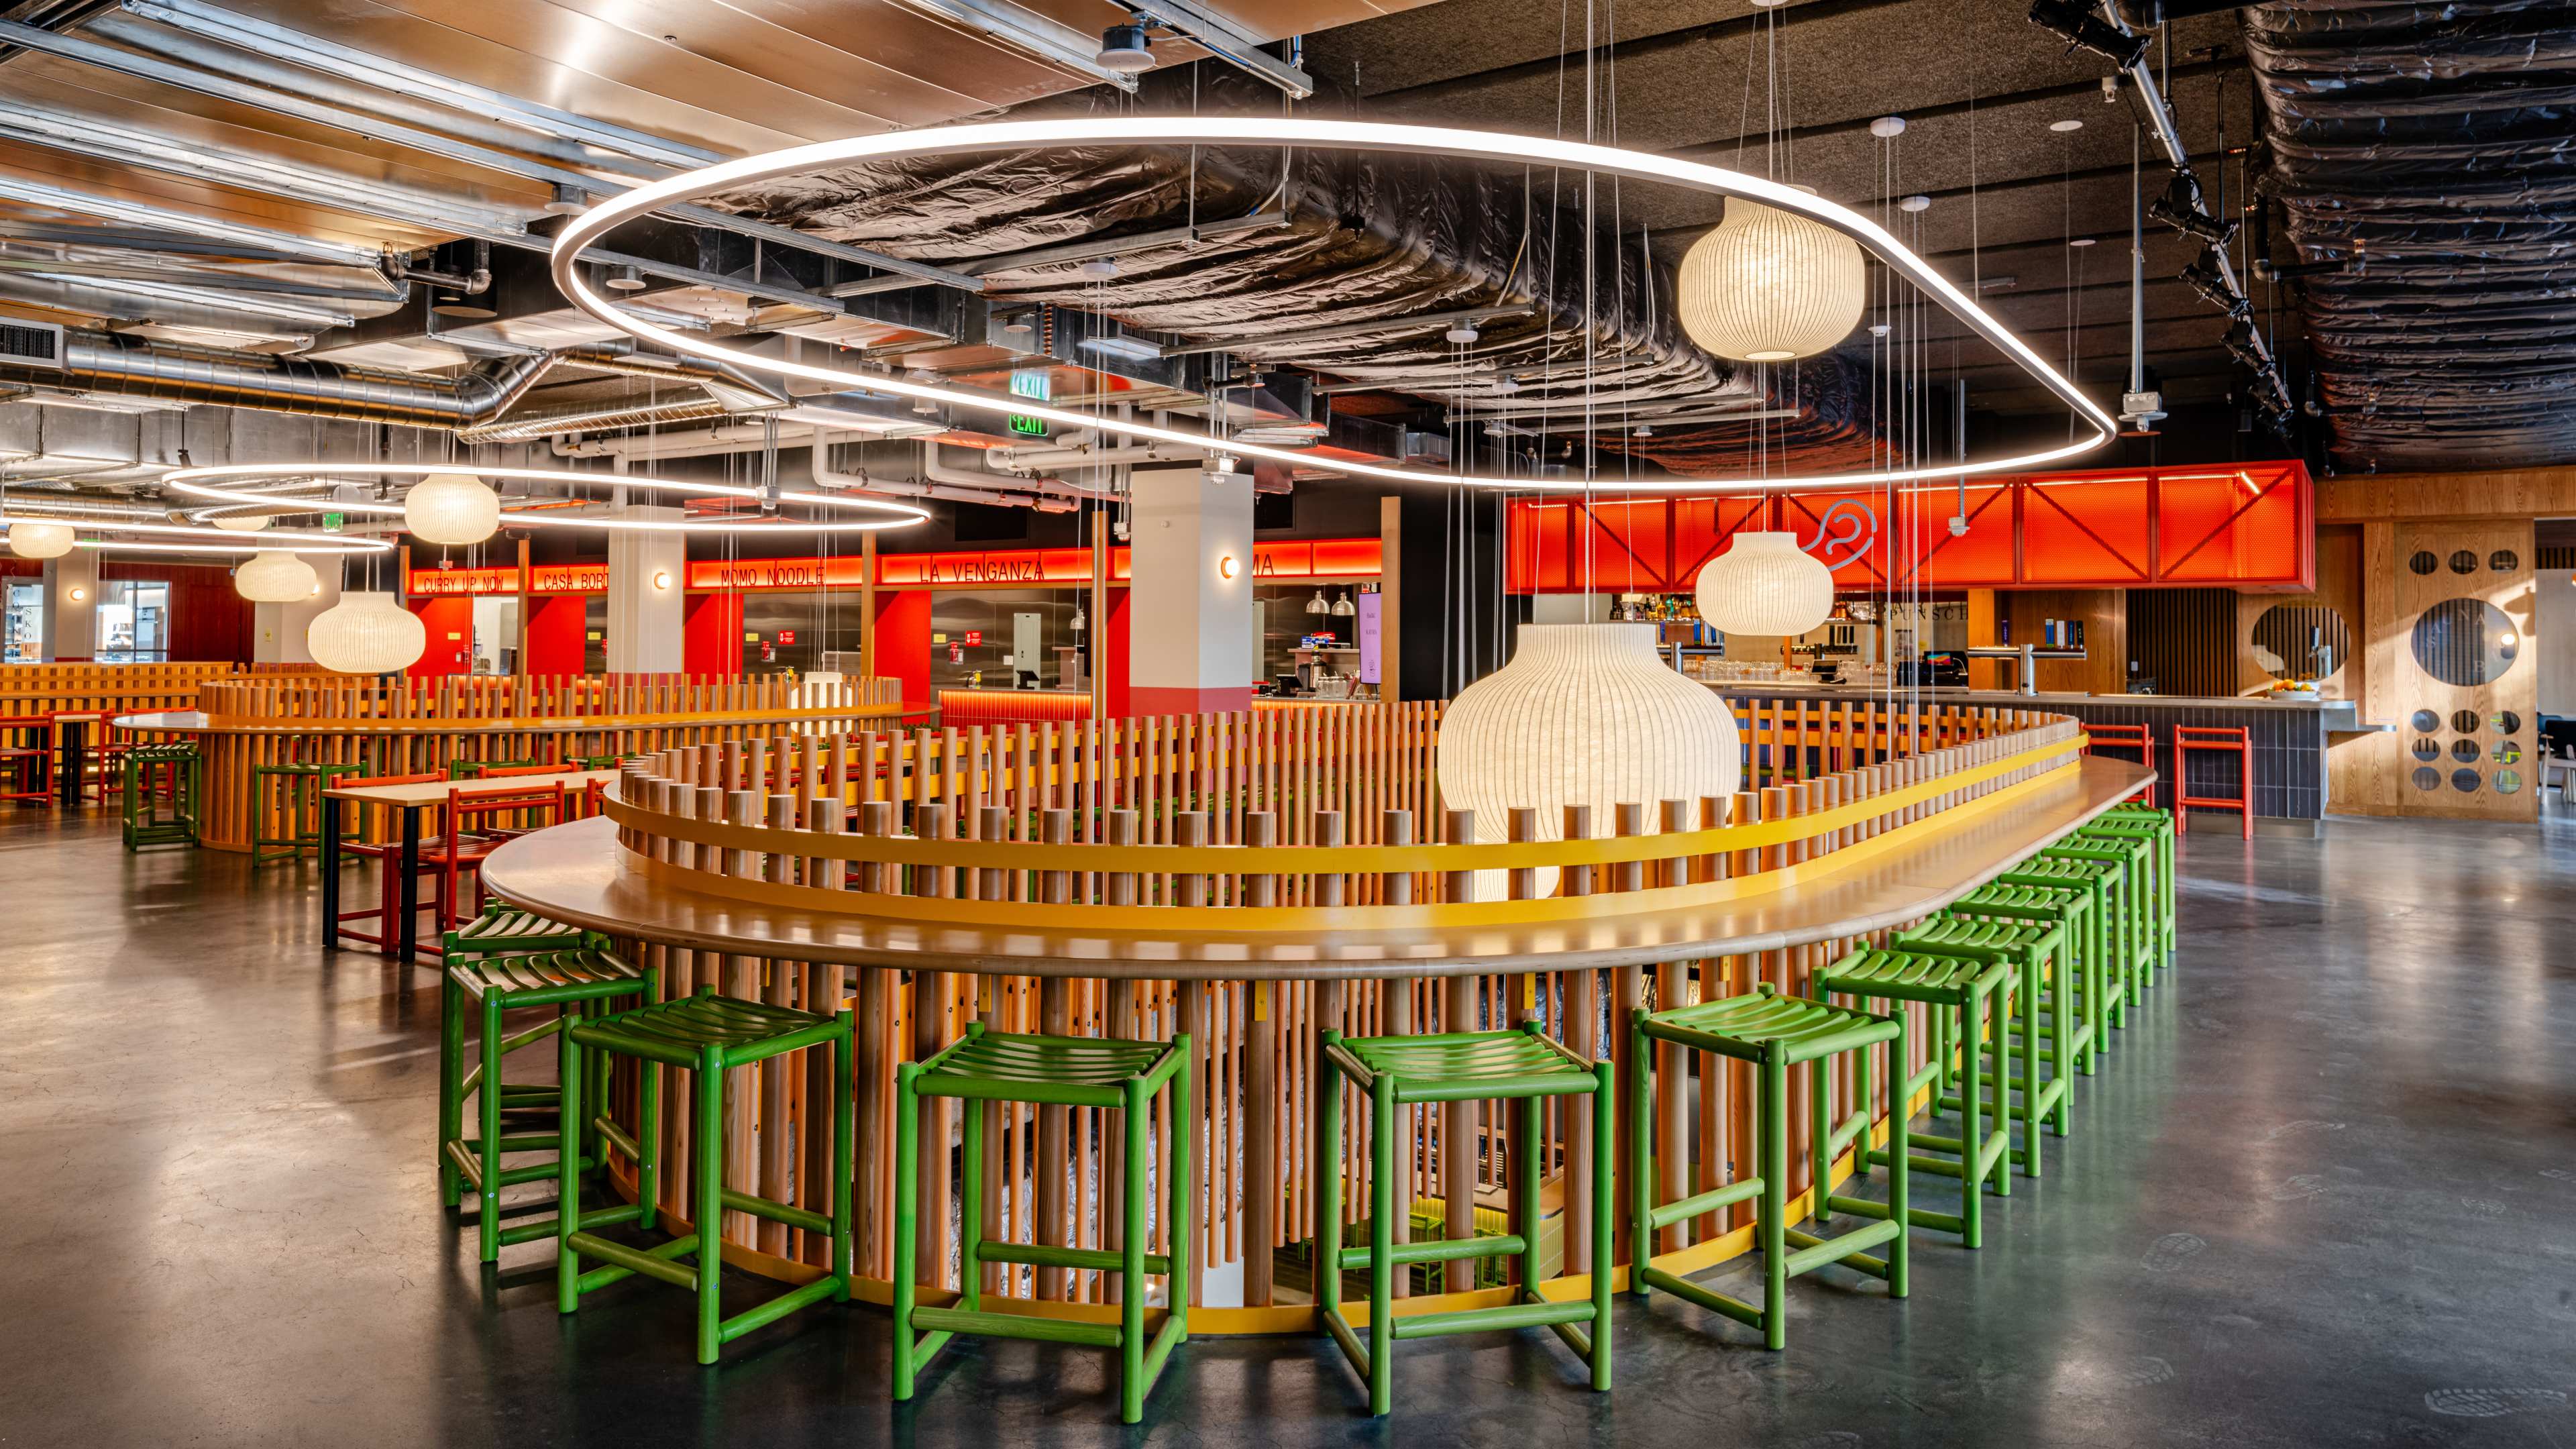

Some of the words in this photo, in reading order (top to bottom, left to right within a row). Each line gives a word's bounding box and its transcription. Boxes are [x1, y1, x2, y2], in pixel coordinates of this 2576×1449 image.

[721, 568, 757, 586] MOMO
[767, 566, 824, 586] NOODLE
[920, 564, 941, 584] LA
[953, 560, 1044, 582] VENGANZA
[424, 577, 456, 592] CURRY
[463, 576, 476, 592] UP
[483, 576, 504, 592] NOW
[544, 574, 574, 590] CASA
